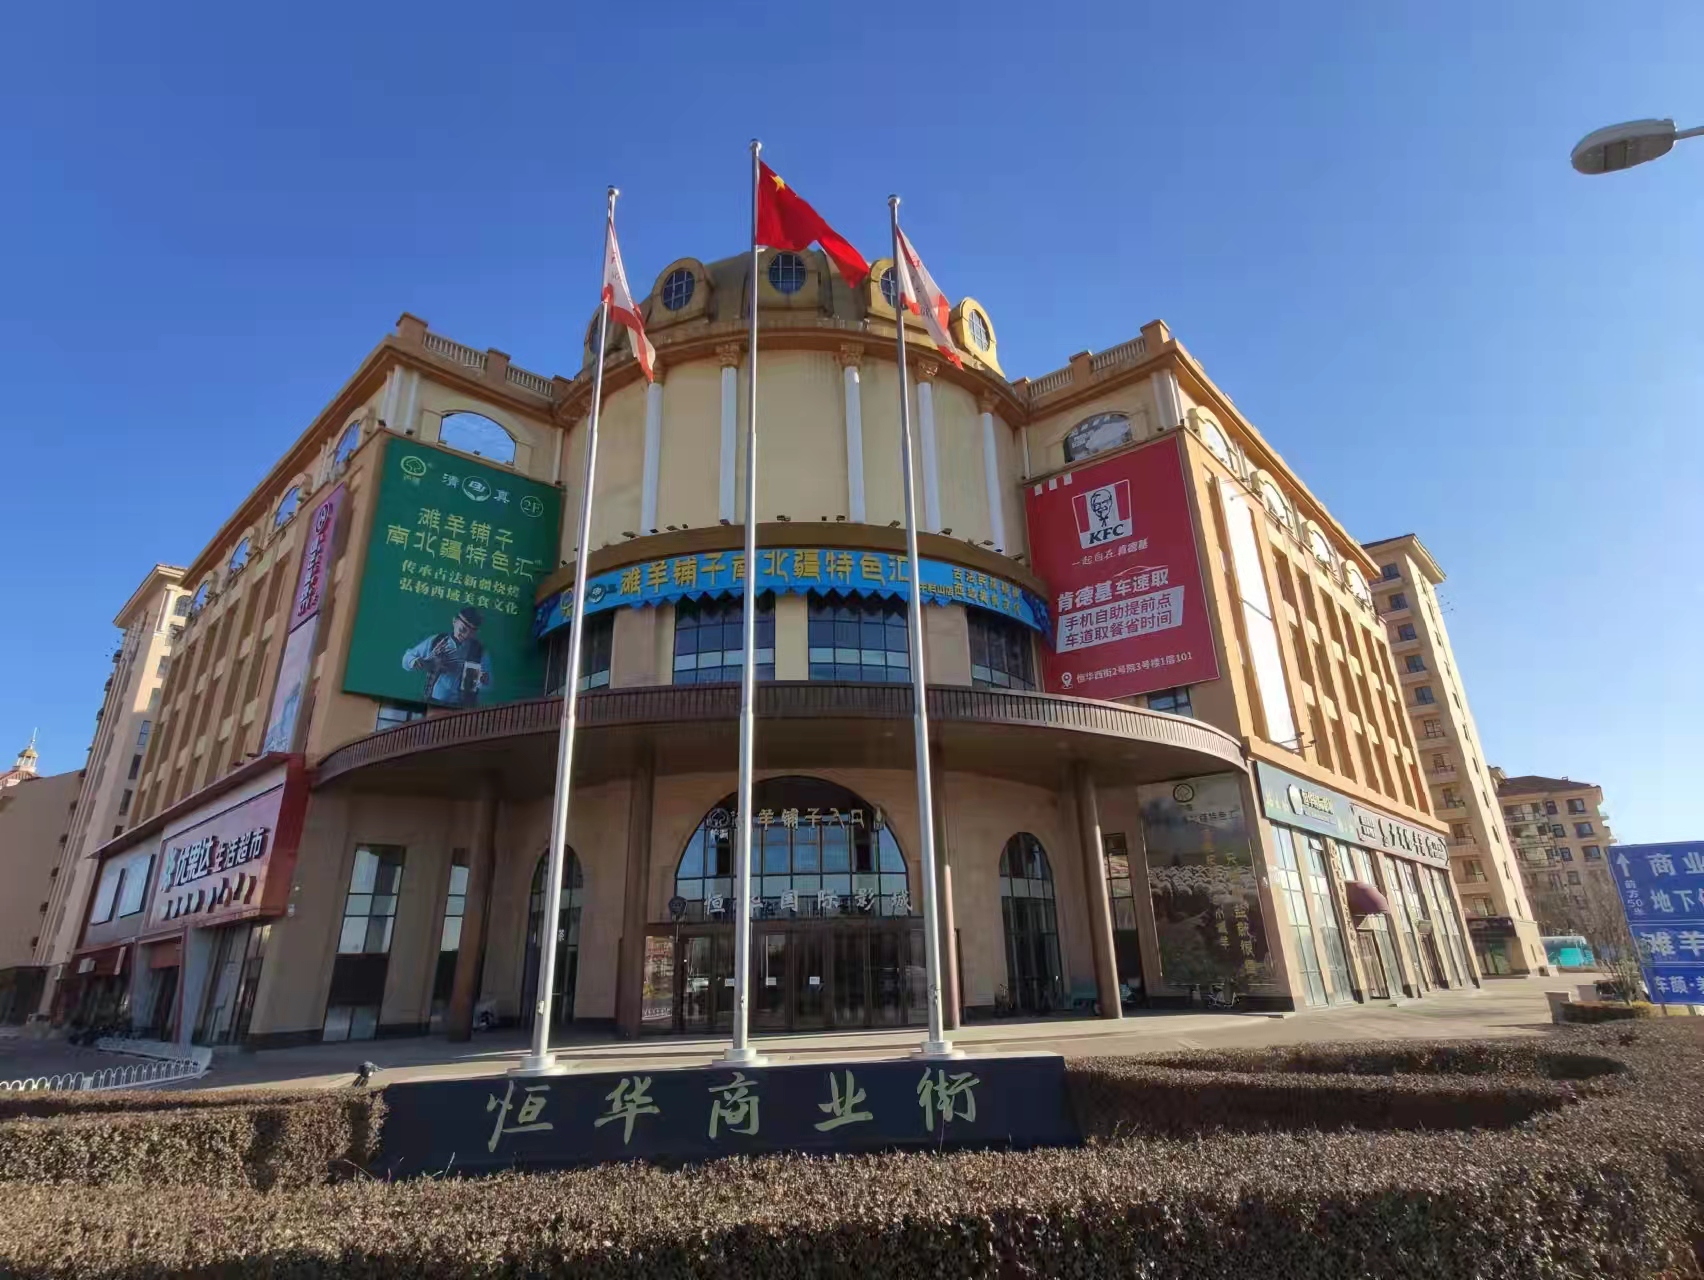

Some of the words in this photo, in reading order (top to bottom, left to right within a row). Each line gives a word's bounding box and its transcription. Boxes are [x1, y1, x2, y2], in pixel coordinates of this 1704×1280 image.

[522, 499, 541, 514] 2F
[386, 524, 535, 583] 南北疆特色汇
[1088, 523, 1125, 546] KFC
[1057, 568, 1169, 612] 肯德基车速取
[1065, 593, 1173, 631] 手机自助提前点
[1065, 610, 1173, 648] 车道取餐省时间
[1648, 851, 1704, 877] 商业
[1650, 888, 1704, 913] 地下
[486, 1066, 980, 1152] 恒华商业街
